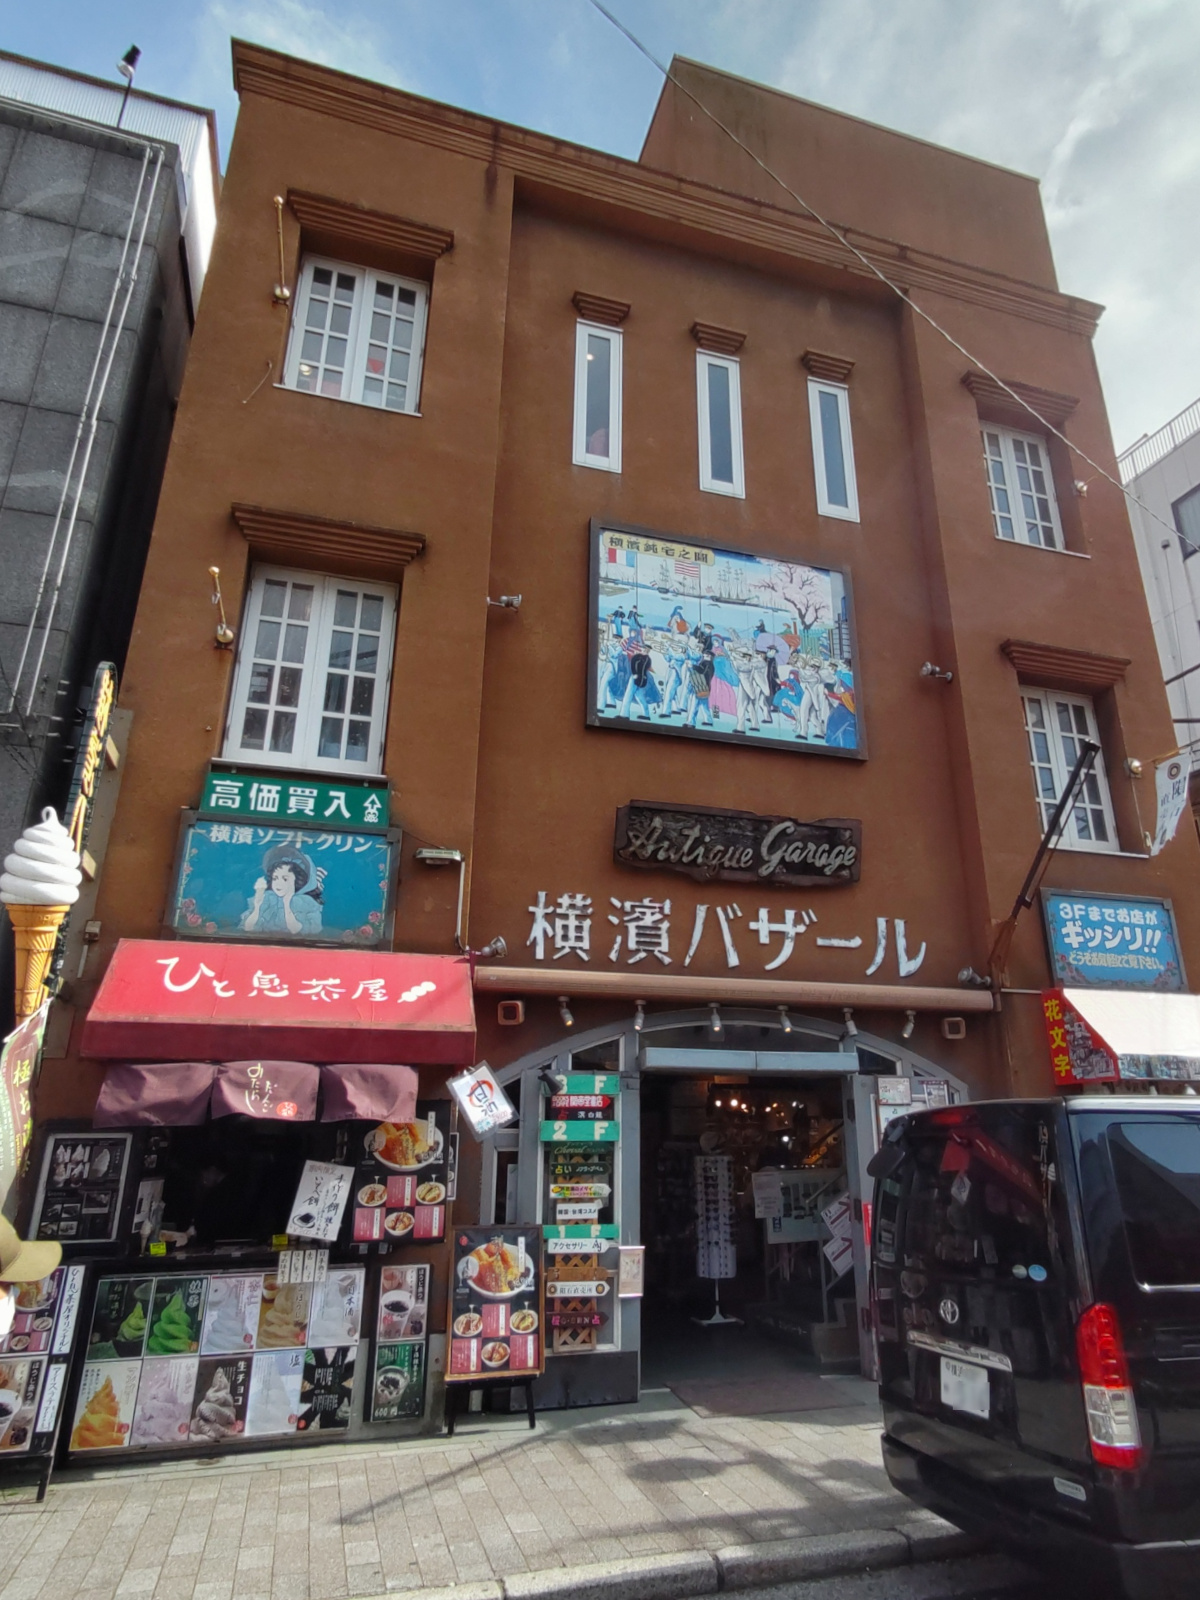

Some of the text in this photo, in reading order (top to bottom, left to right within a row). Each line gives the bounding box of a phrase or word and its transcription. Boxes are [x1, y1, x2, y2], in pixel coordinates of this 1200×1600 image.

[210, 779, 351, 819] 高価買入
[617, 815, 857, 877] Antique Garage
[526, 890, 927, 978] 横濱バザール
[1059, 902, 1158, 926] 3Fまでお店が
[156, 956, 389, 1002] ひと息茶屋
[1043, 999, 1071, 1078] 花文字
[245, 1062, 264, 1114] みたらし
[594, 1075, 607, 1095] F
[553, 1121, 609, 1141] 2 F
[555, 1165, 572, 1174] 占い
[234, 1360, 247, 1405] 生チョコ
